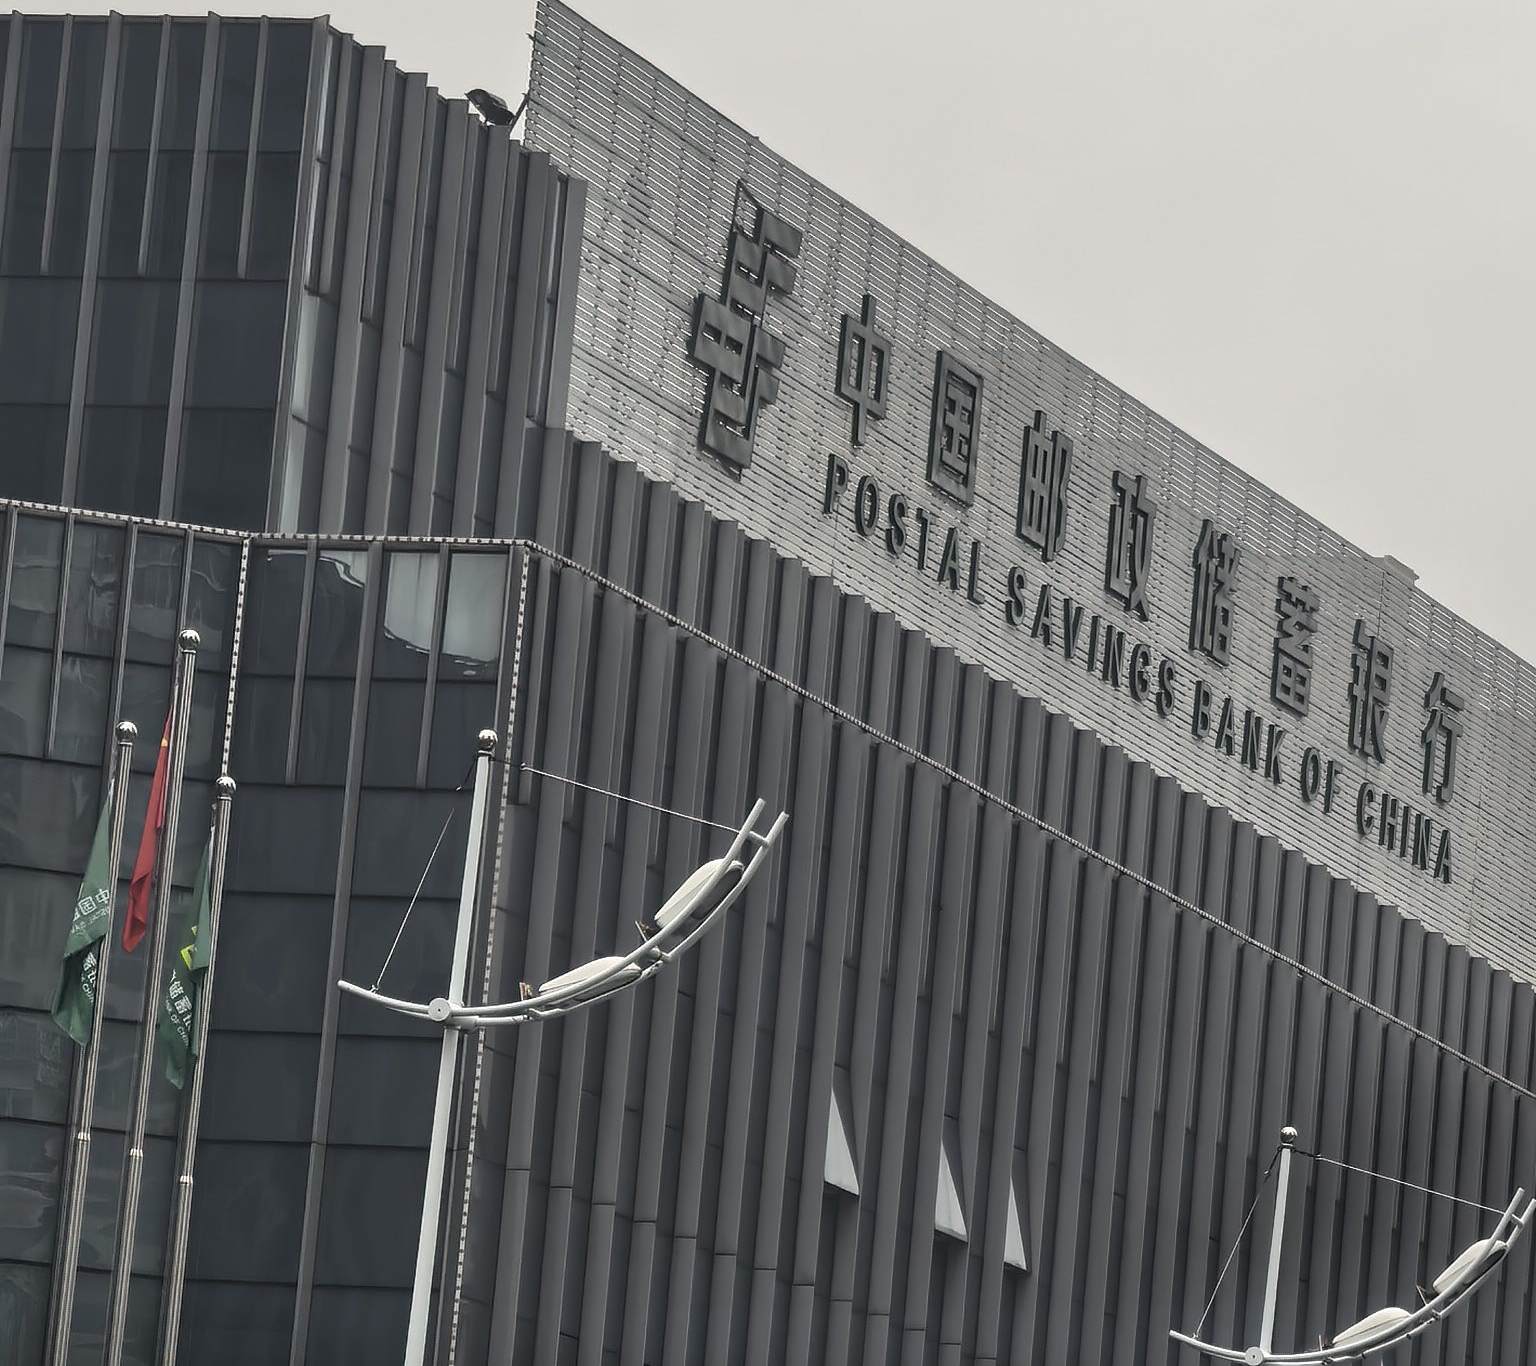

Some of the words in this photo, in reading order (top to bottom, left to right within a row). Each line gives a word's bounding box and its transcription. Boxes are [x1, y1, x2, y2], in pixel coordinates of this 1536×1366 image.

[823, 453, 985, 605] POSTAL
[1005, 566, 1176, 719] SAVINGS
[1191, 680, 1288, 785] BANK
[1300, 747, 1344, 815] OF
[1356, 782, 1451, 885] CHINA
[834, 294, 1465, 803] 中国邮政储蓄银行
